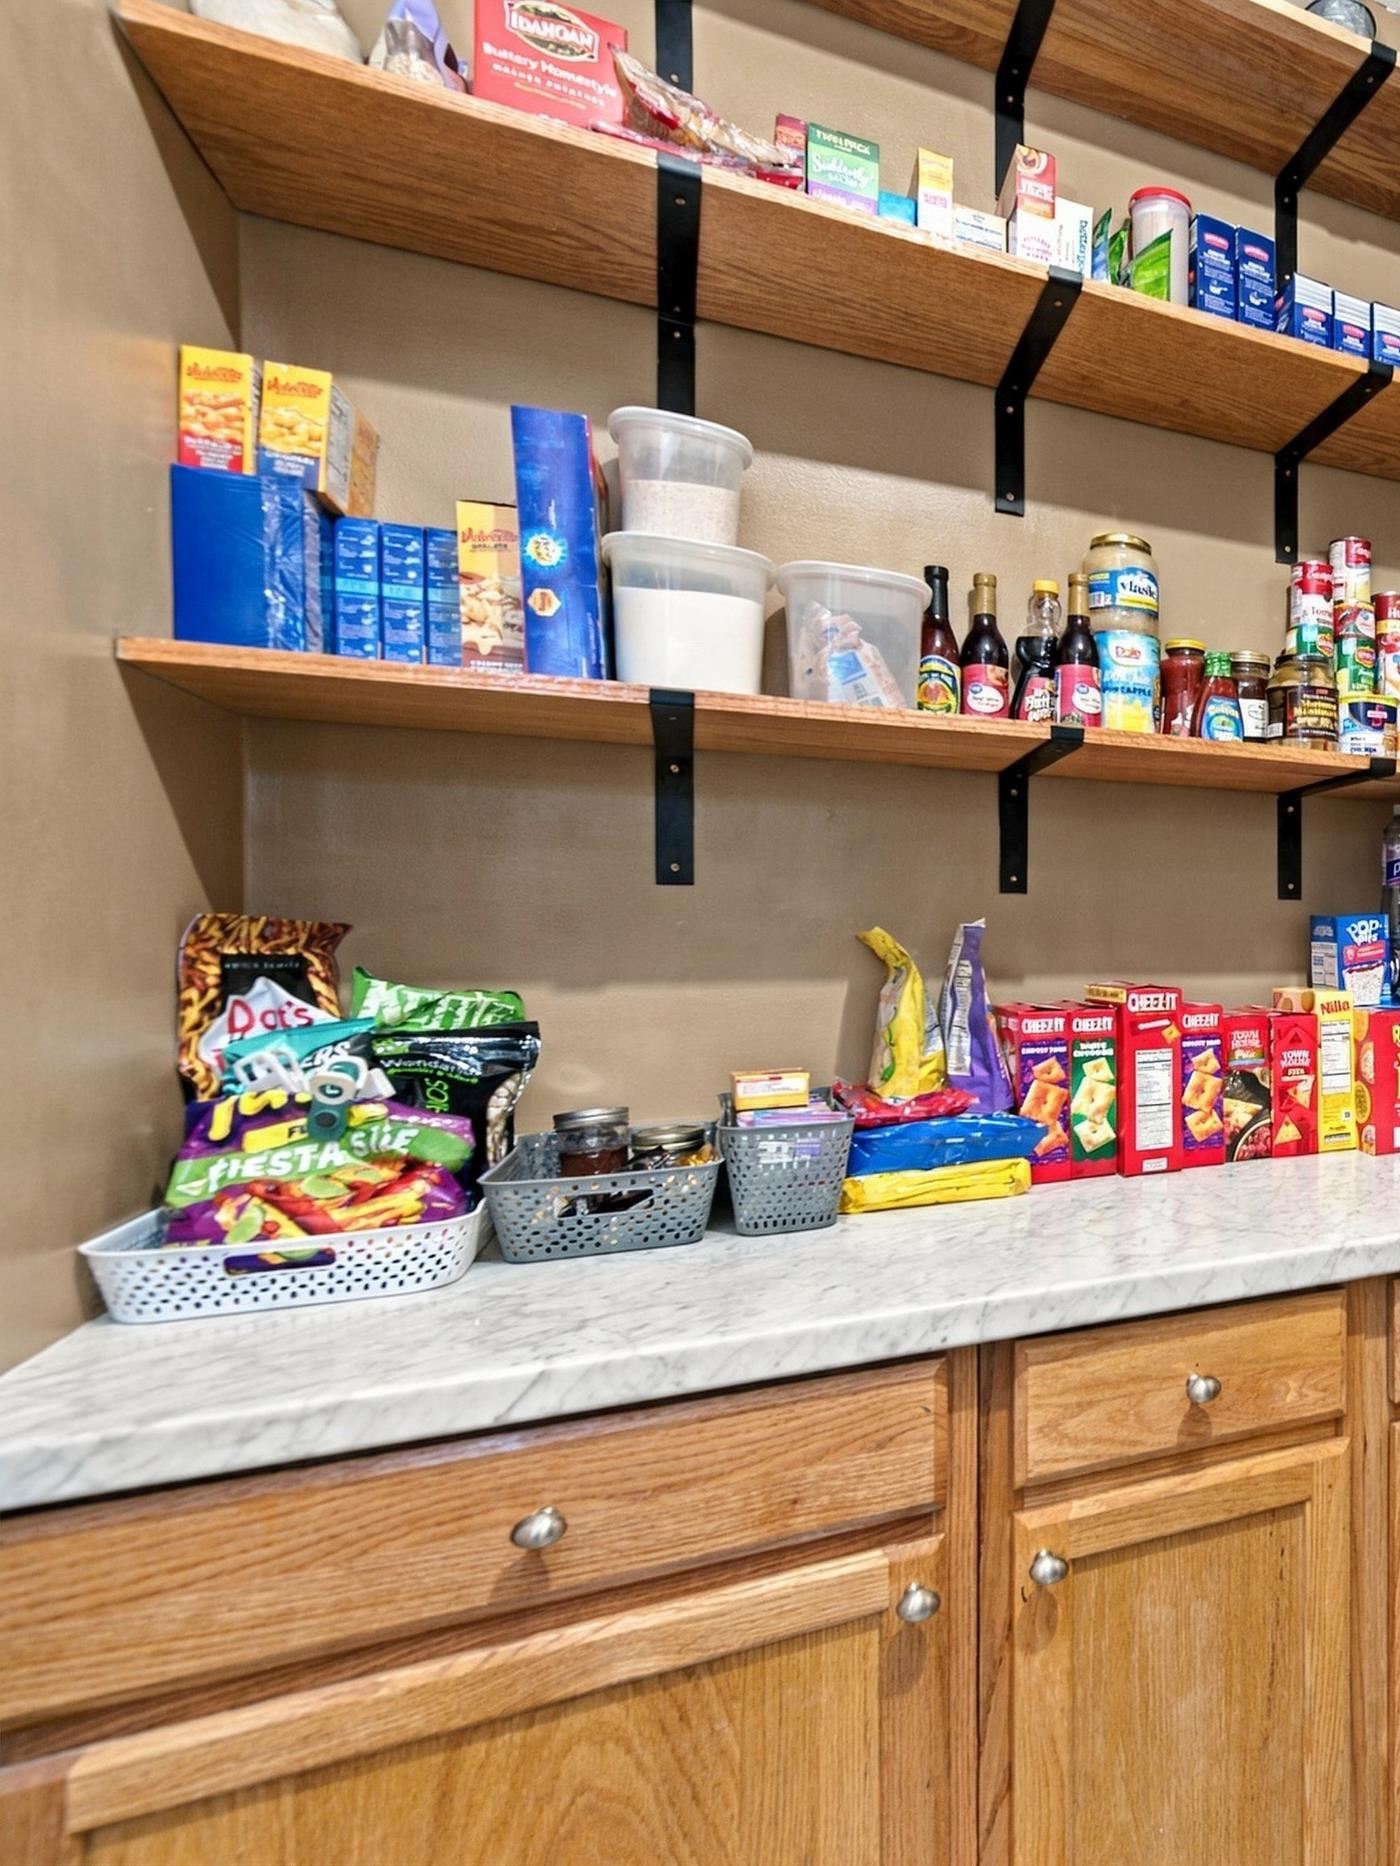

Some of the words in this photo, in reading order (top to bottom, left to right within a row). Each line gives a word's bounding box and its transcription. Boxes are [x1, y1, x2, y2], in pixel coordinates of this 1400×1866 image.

[510, 11, 593, 47] IDAHOAN
[482, 41, 539, 69] Buttery
[540, 60, 617, 98] Homestyle
[1115, 646, 1141, 660] Dole
[228, 998, 314, 1034] Dot's
[1320, 999, 1351, 1015] Nilla
[1281, 1050, 1310, 1061] TOWN
[208, 1142, 347, 1192] FIESTA
